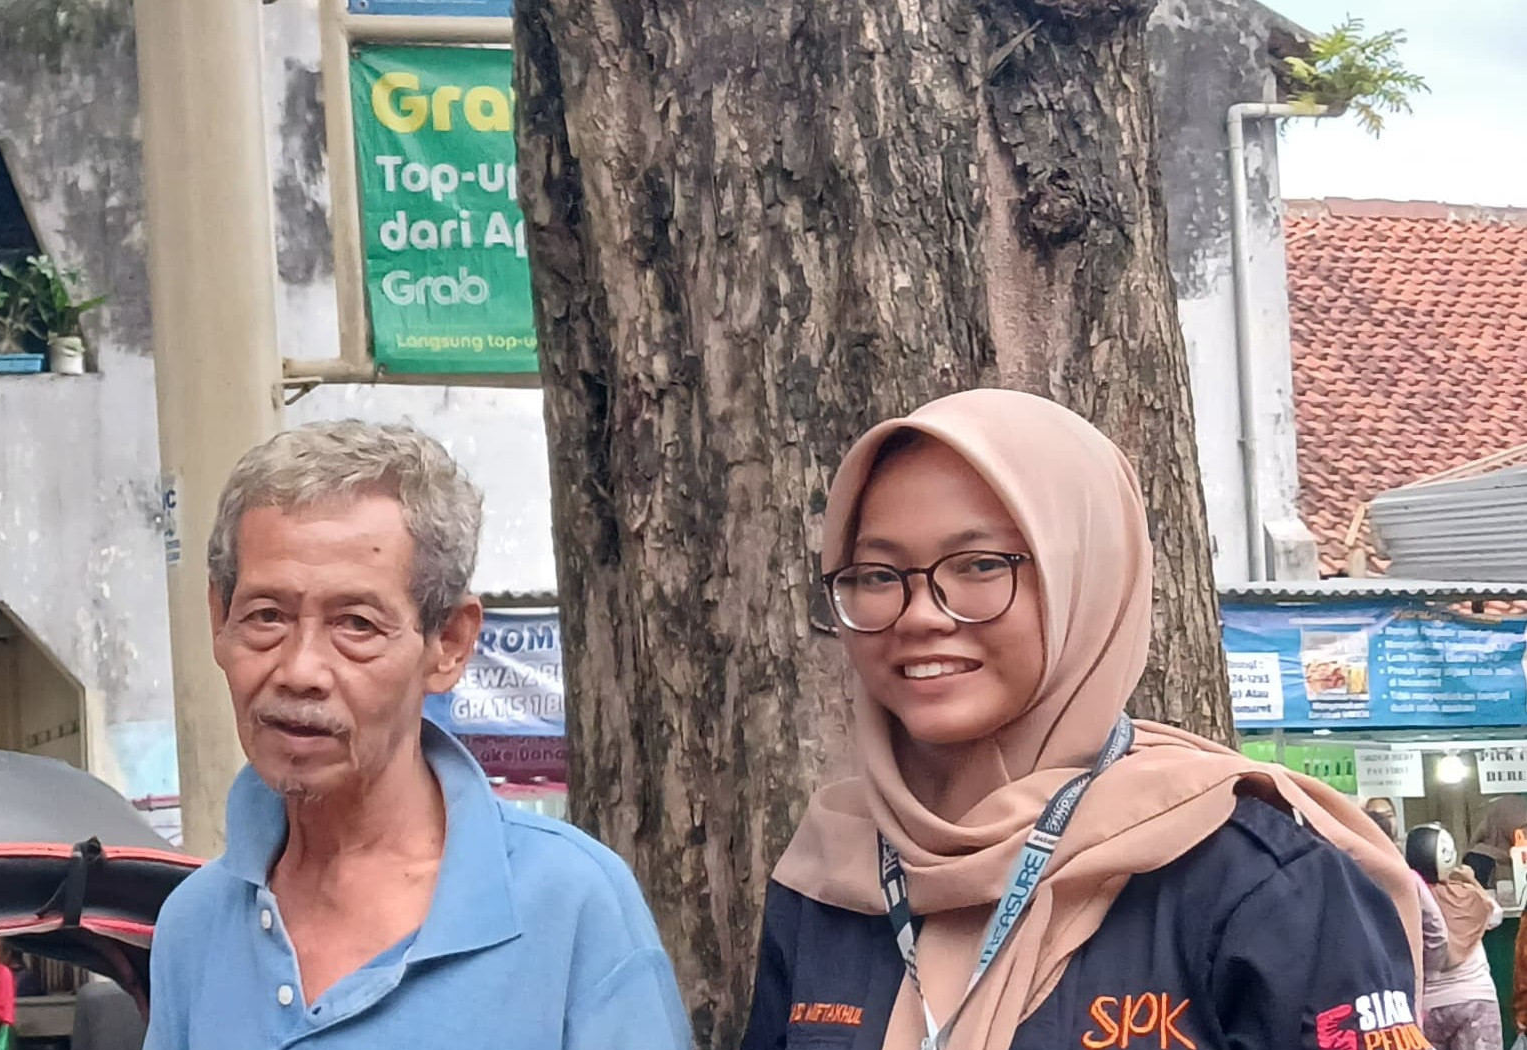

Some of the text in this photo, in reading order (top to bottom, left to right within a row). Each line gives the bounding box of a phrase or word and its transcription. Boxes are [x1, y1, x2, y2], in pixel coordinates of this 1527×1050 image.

[371, 72, 515, 133] Gra
[379, 210, 471, 251] dari
[382, 267, 490, 306] Grab
[395, 332, 483, 353] Langsung
[451, 694, 526, 720] GRATIS
